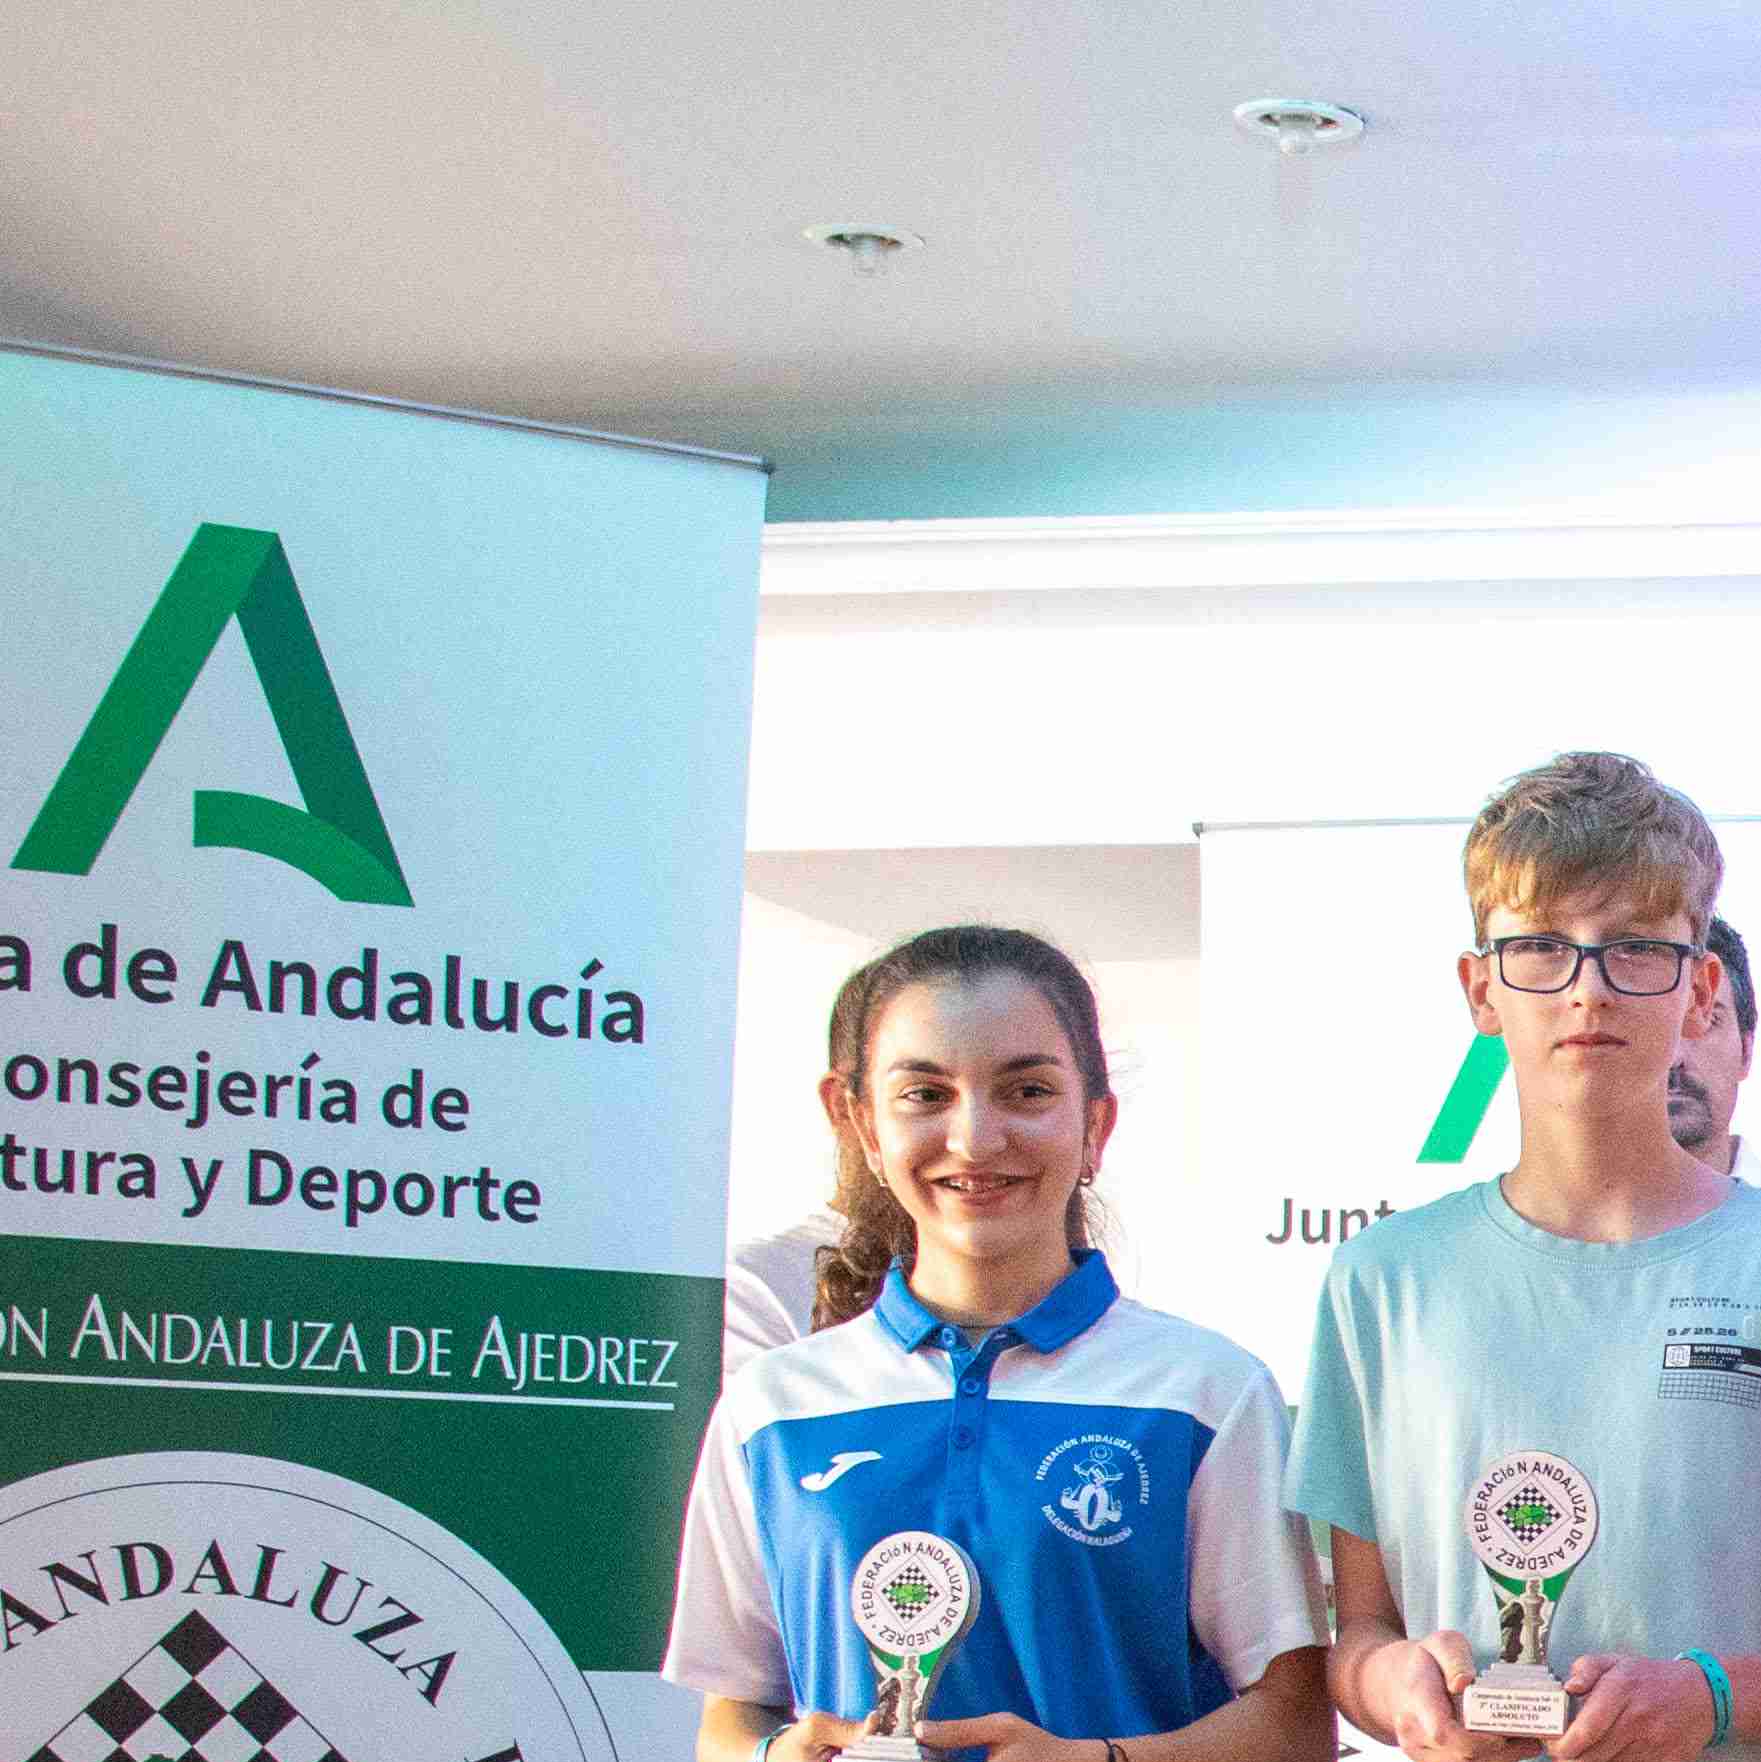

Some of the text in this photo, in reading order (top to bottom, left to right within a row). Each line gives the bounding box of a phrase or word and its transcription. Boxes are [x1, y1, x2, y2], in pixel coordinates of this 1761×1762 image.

[64, 923, 178, 1003] de
[201, 940, 645, 1044] Andalucía
[2, 1049, 470, 1131] onsejería de
[0, 1133, 541, 1228] tura y Deporte
[70, 1293, 366, 1373] ANDALUZA
[388, 1326, 451, 1377] DE
[471, 1315, 679, 1391] AJEDREZ
[1532, 1461, 1588, 1525] ANDALUZA
[1495, 1546, 1566, 1571] AJEDREZ
[1564, 1528, 1584, 1551] DE
[916, 1541, 963, 1604] ANDALUZA
[0, 1539, 461, 1709] ANDALUZA
[879, 1624, 942, 1647] AJEDREZ
[941, 1606, 959, 1628] DE
